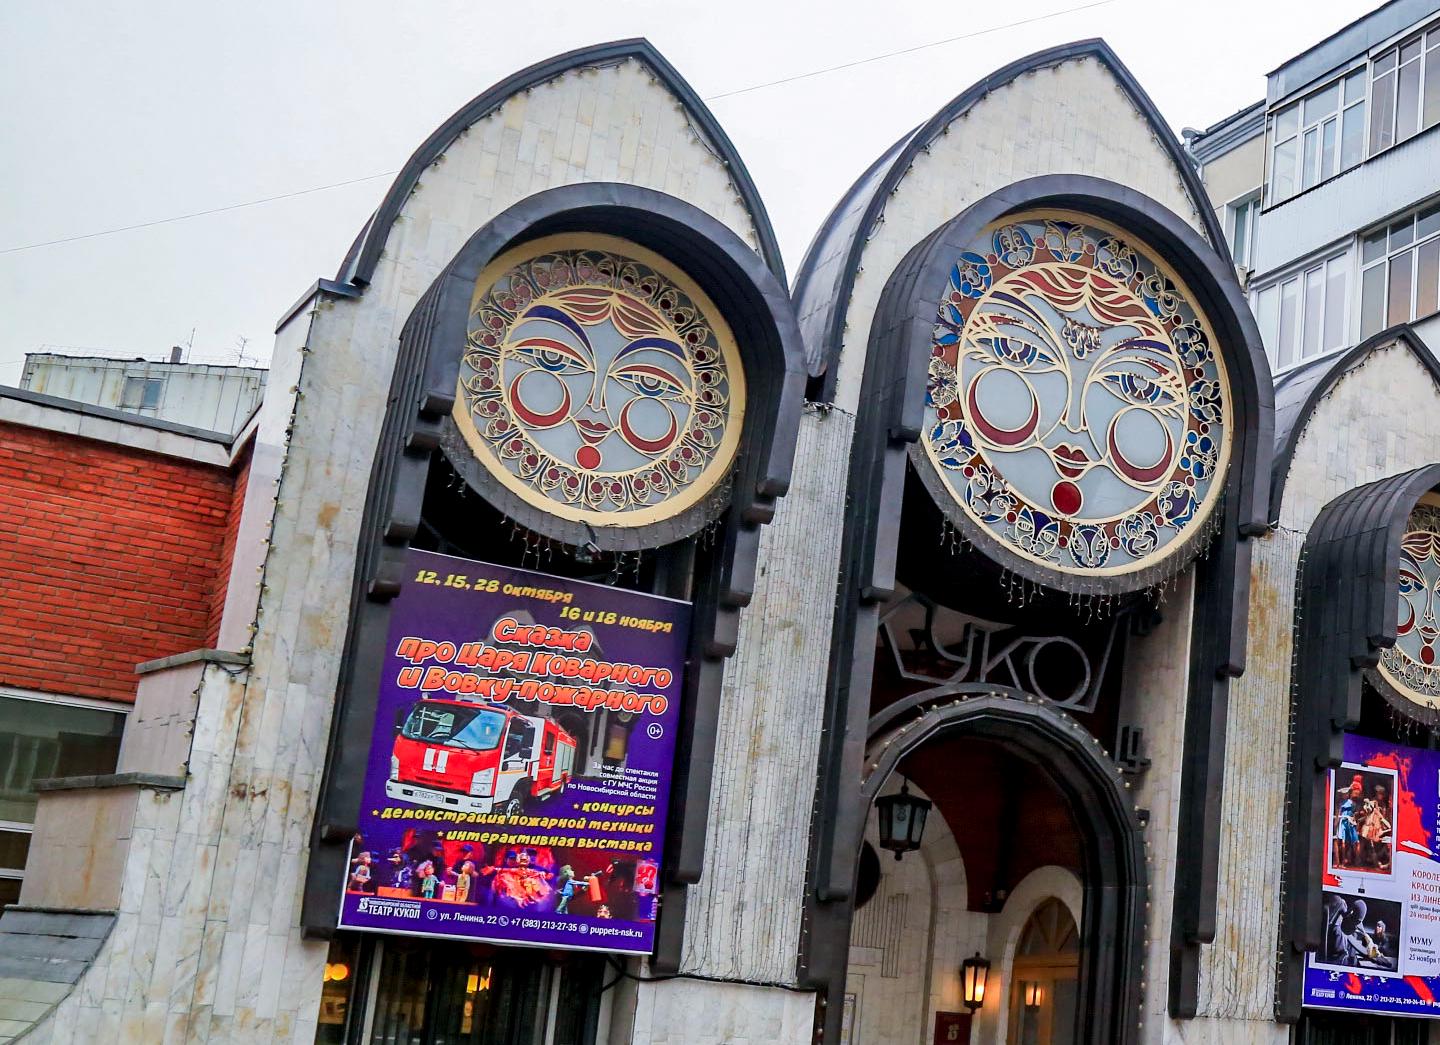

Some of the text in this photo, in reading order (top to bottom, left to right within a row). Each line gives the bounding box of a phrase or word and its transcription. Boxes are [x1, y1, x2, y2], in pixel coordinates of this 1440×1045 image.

[415, 570, 573, 604] 12, 15, 28 октября
[560, 606, 673, 633] 16 и 18 ноября
[493, 617, 593, 652] Сказка
[396, 637, 456, 663] про
[530, 652, 672, 687] Коварного
[397, 667, 668, 716] и Вовку-пожарного
[648, 725, 662, 737] 0+
[599, 772, 658, 785] совместная акция
[625, 768, 659, 777] спектакля
[577, 784, 629, 796] Новосибирской
[629, 790, 656, 800] области
[618, 781, 633, 789] МЧС
[634, 783, 657, 792] России
[582, 802, 655, 816] конкурсы
[380, 806, 654, 834] демонстрация пожарной техники
[446, 830, 653, 852] интерактивная выставка
[1411, 893, 1421, 901] ИЗ
[368, 905, 421, 919] ТЕАТР КУКОЛ
[439, 912, 497, 924] ул. Ленина, 22
[1417, 912, 1438, 922] ноября
[511, 918, 578, 932] +7 (383) 213-27-35
[589, 926, 643, 938] puppets-nsk.ru
[1410, 936, 1432, 946] МУМУ
[1416, 955, 1437, 965] ноября
